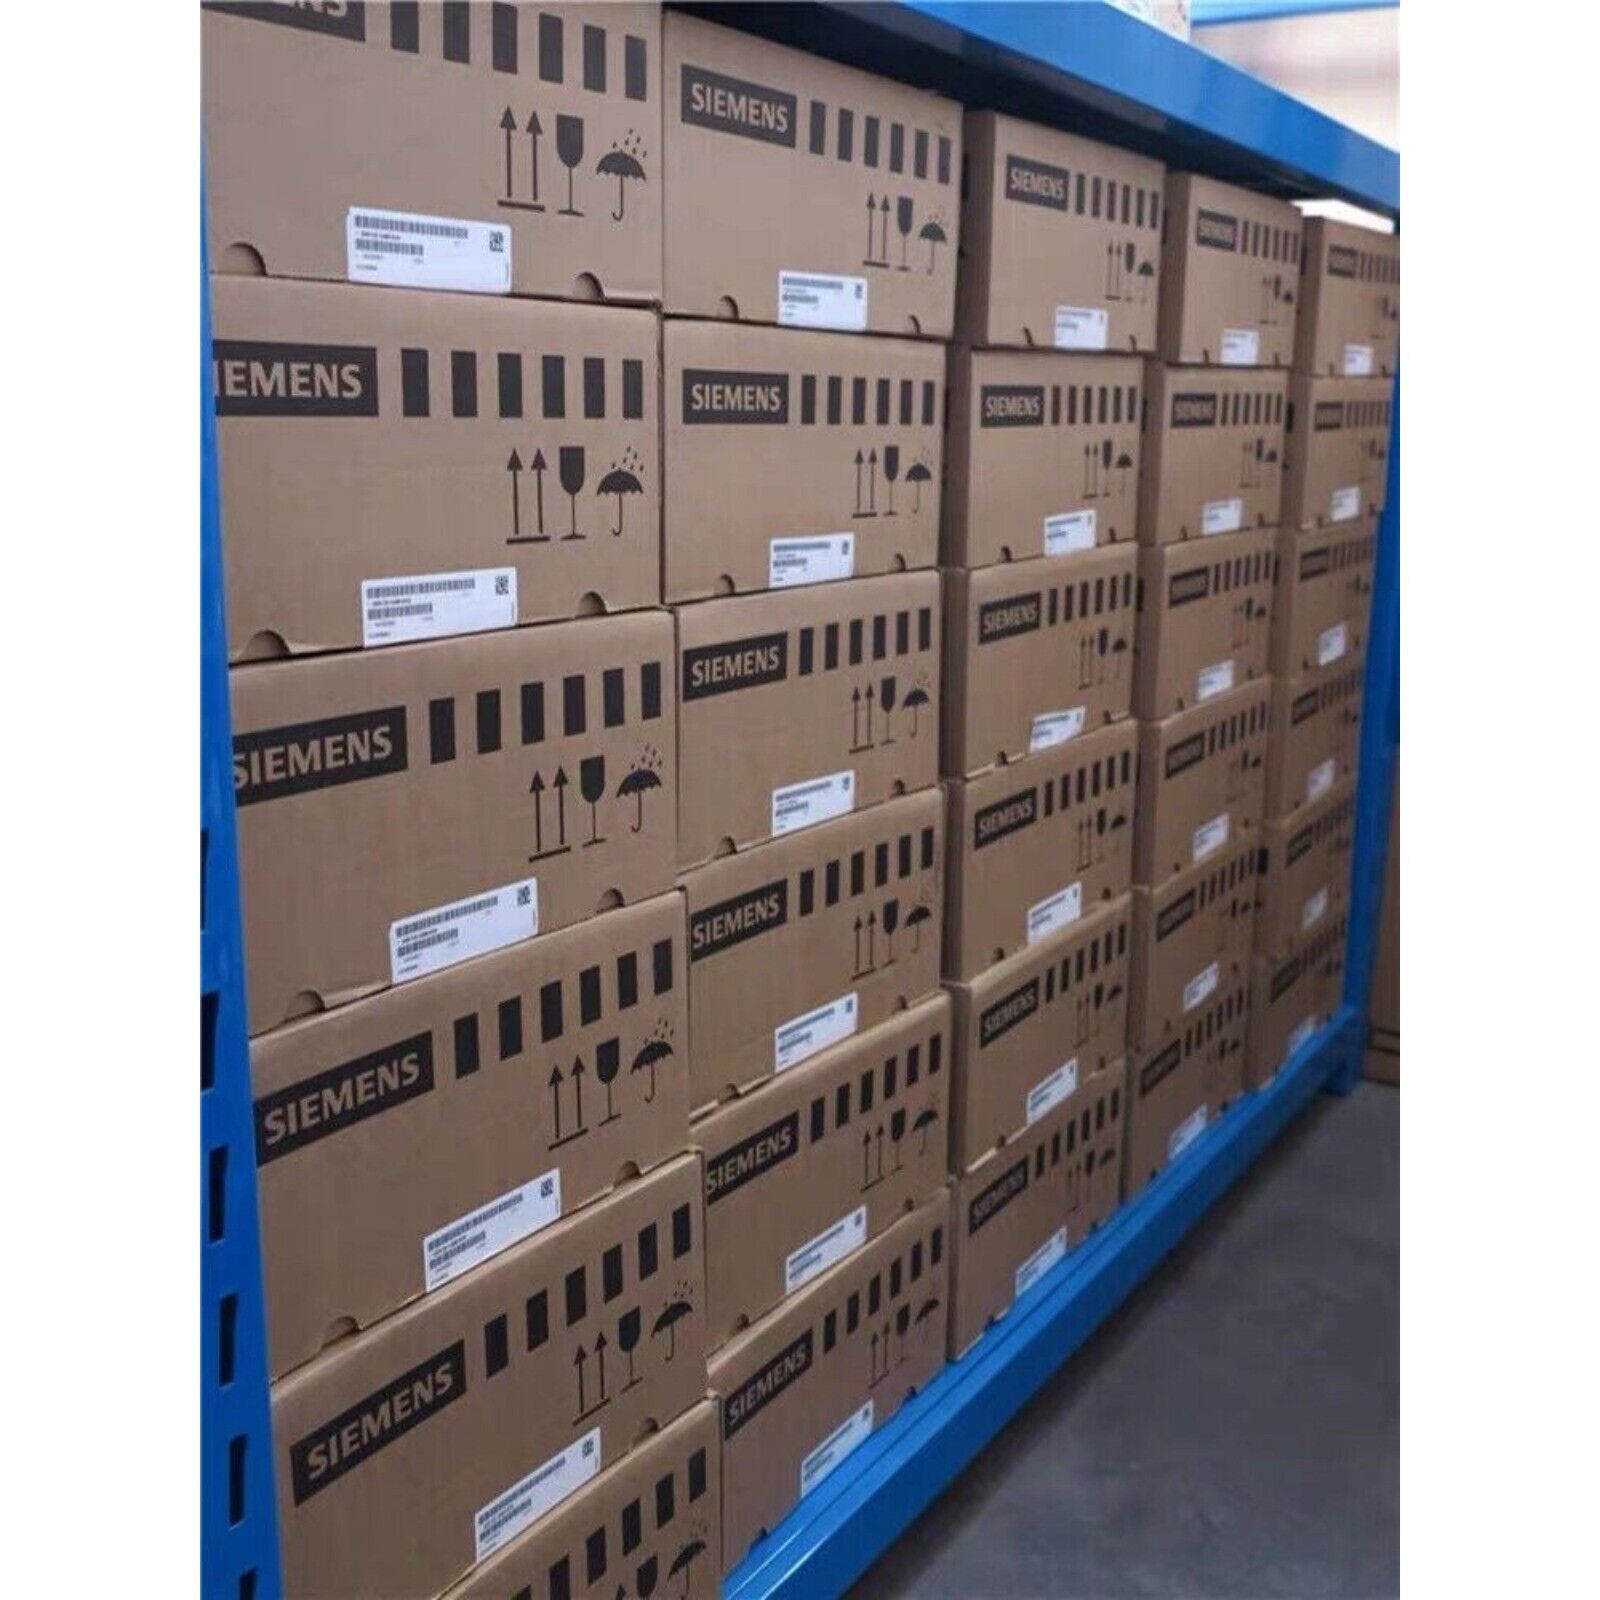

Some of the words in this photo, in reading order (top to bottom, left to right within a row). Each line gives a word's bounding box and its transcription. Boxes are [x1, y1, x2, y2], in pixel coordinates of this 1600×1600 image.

[692, 83, 788, 133] SIEMENS
[1010, 167, 1064, 199] SIEMENS
[213, 360, 362, 398] IEMENS
[691, 383, 781, 412] SIEMENS
[985, 395, 1040, 418] SIEMENS
[692, 645, 779, 687] SIEMENS
[233, 725, 393, 790] SIEMENS
[693, 894, 779, 949] SIEMENS
[264, 1052, 420, 1145] SIEMENS
[706, 1126, 792, 1195] SIEMENS
[729, 1344, 806, 1426] SIEMENS
[307, 1363, 453, 1479] SIEMENS
